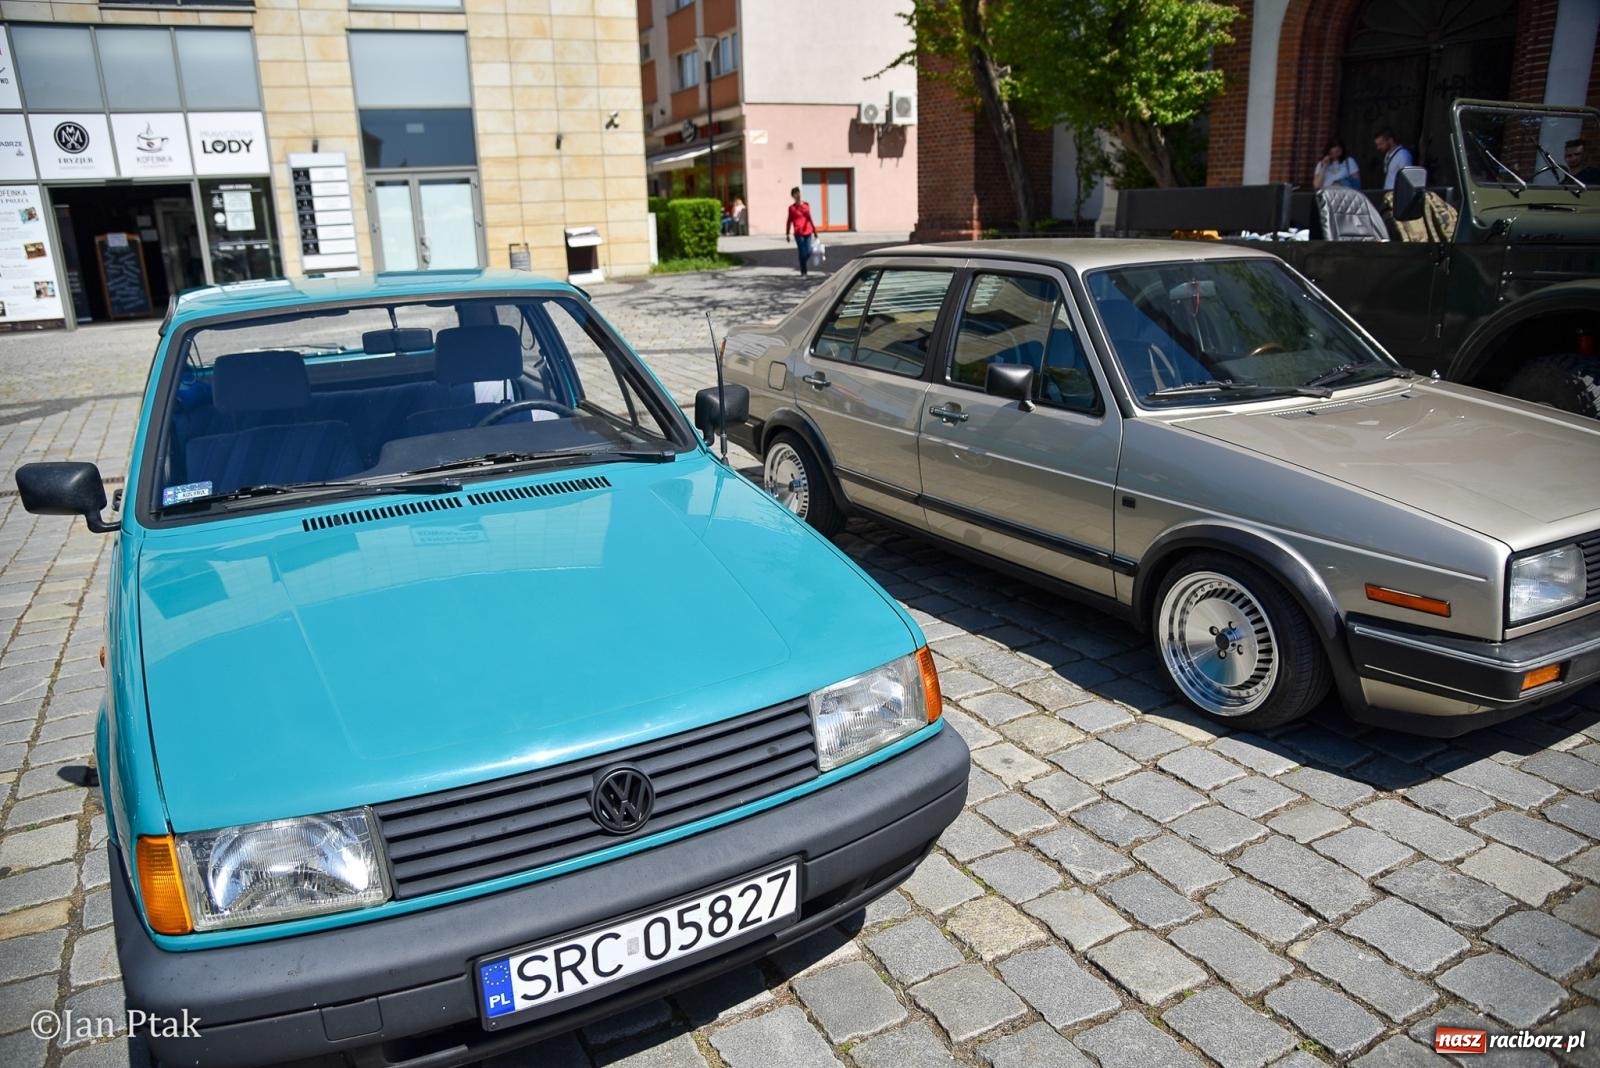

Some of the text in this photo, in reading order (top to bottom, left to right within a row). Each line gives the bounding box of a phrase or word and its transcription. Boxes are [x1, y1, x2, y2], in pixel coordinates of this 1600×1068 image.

[202, 140, 253, 154] LODY
[595, 768, 653, 832] VW
[516, 869, 792, 1001] SRC 05827
[488, 993, 512, 1009] PL
